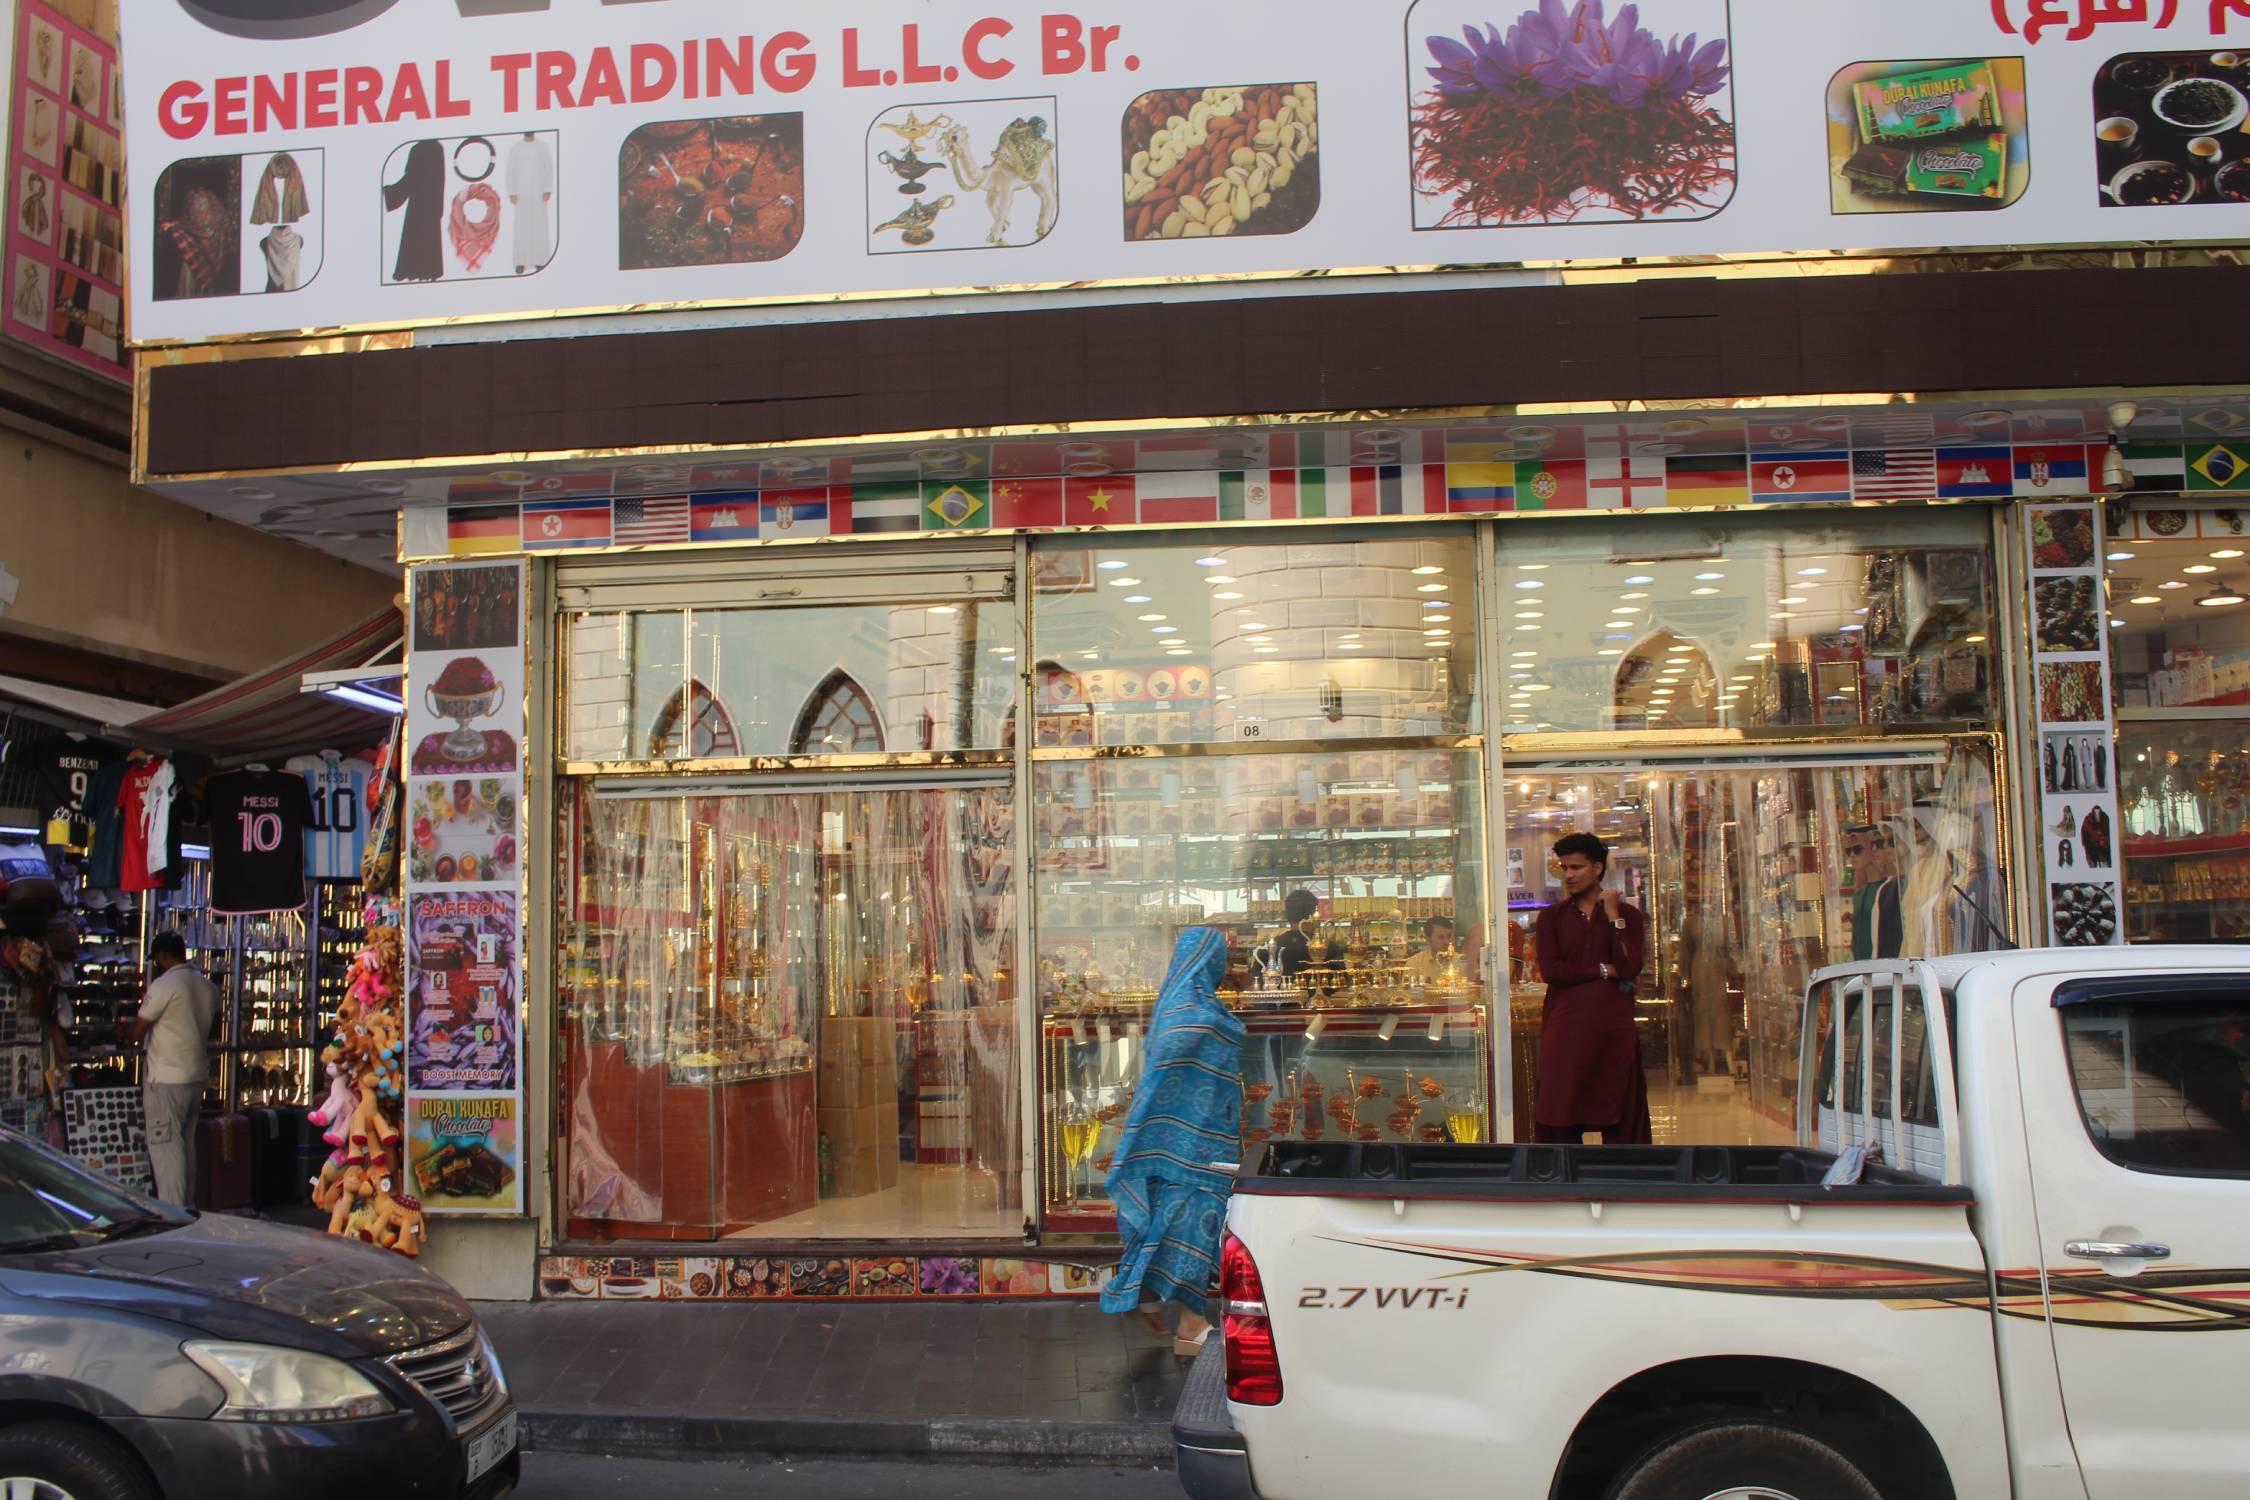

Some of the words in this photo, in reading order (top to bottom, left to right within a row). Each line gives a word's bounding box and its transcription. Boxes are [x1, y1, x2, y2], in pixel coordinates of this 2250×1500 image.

[157, 59, 470, 140] GENERAL
[491, 31, 817, 113] TRADING
[842, 17, 1015, 88] L.L.C
[1041, 14, 1140, 75] Br.
[1243, 725, 1260, 737] 08
[319, 772, 350, 783] MESSI
[69, 771, 88, 811] 9
[243, 796, 279, 808] MESSI
[312, 787, 357, 832] 10
[237, 812, 282, 852] 10
[422, 901, 507, 917] SAFFRON
[423, 1069, 457, 1080] BOOST
[458, 1069, 503, 1080] MEMORY
[421, 1100, 457, 1118] DUBAI
[460, 1099, 508, 1118] KUNAFA
[1297, 1287, 1368, 1309] 2.7
[1374, 1287, 1468, 1310] VVT-i
